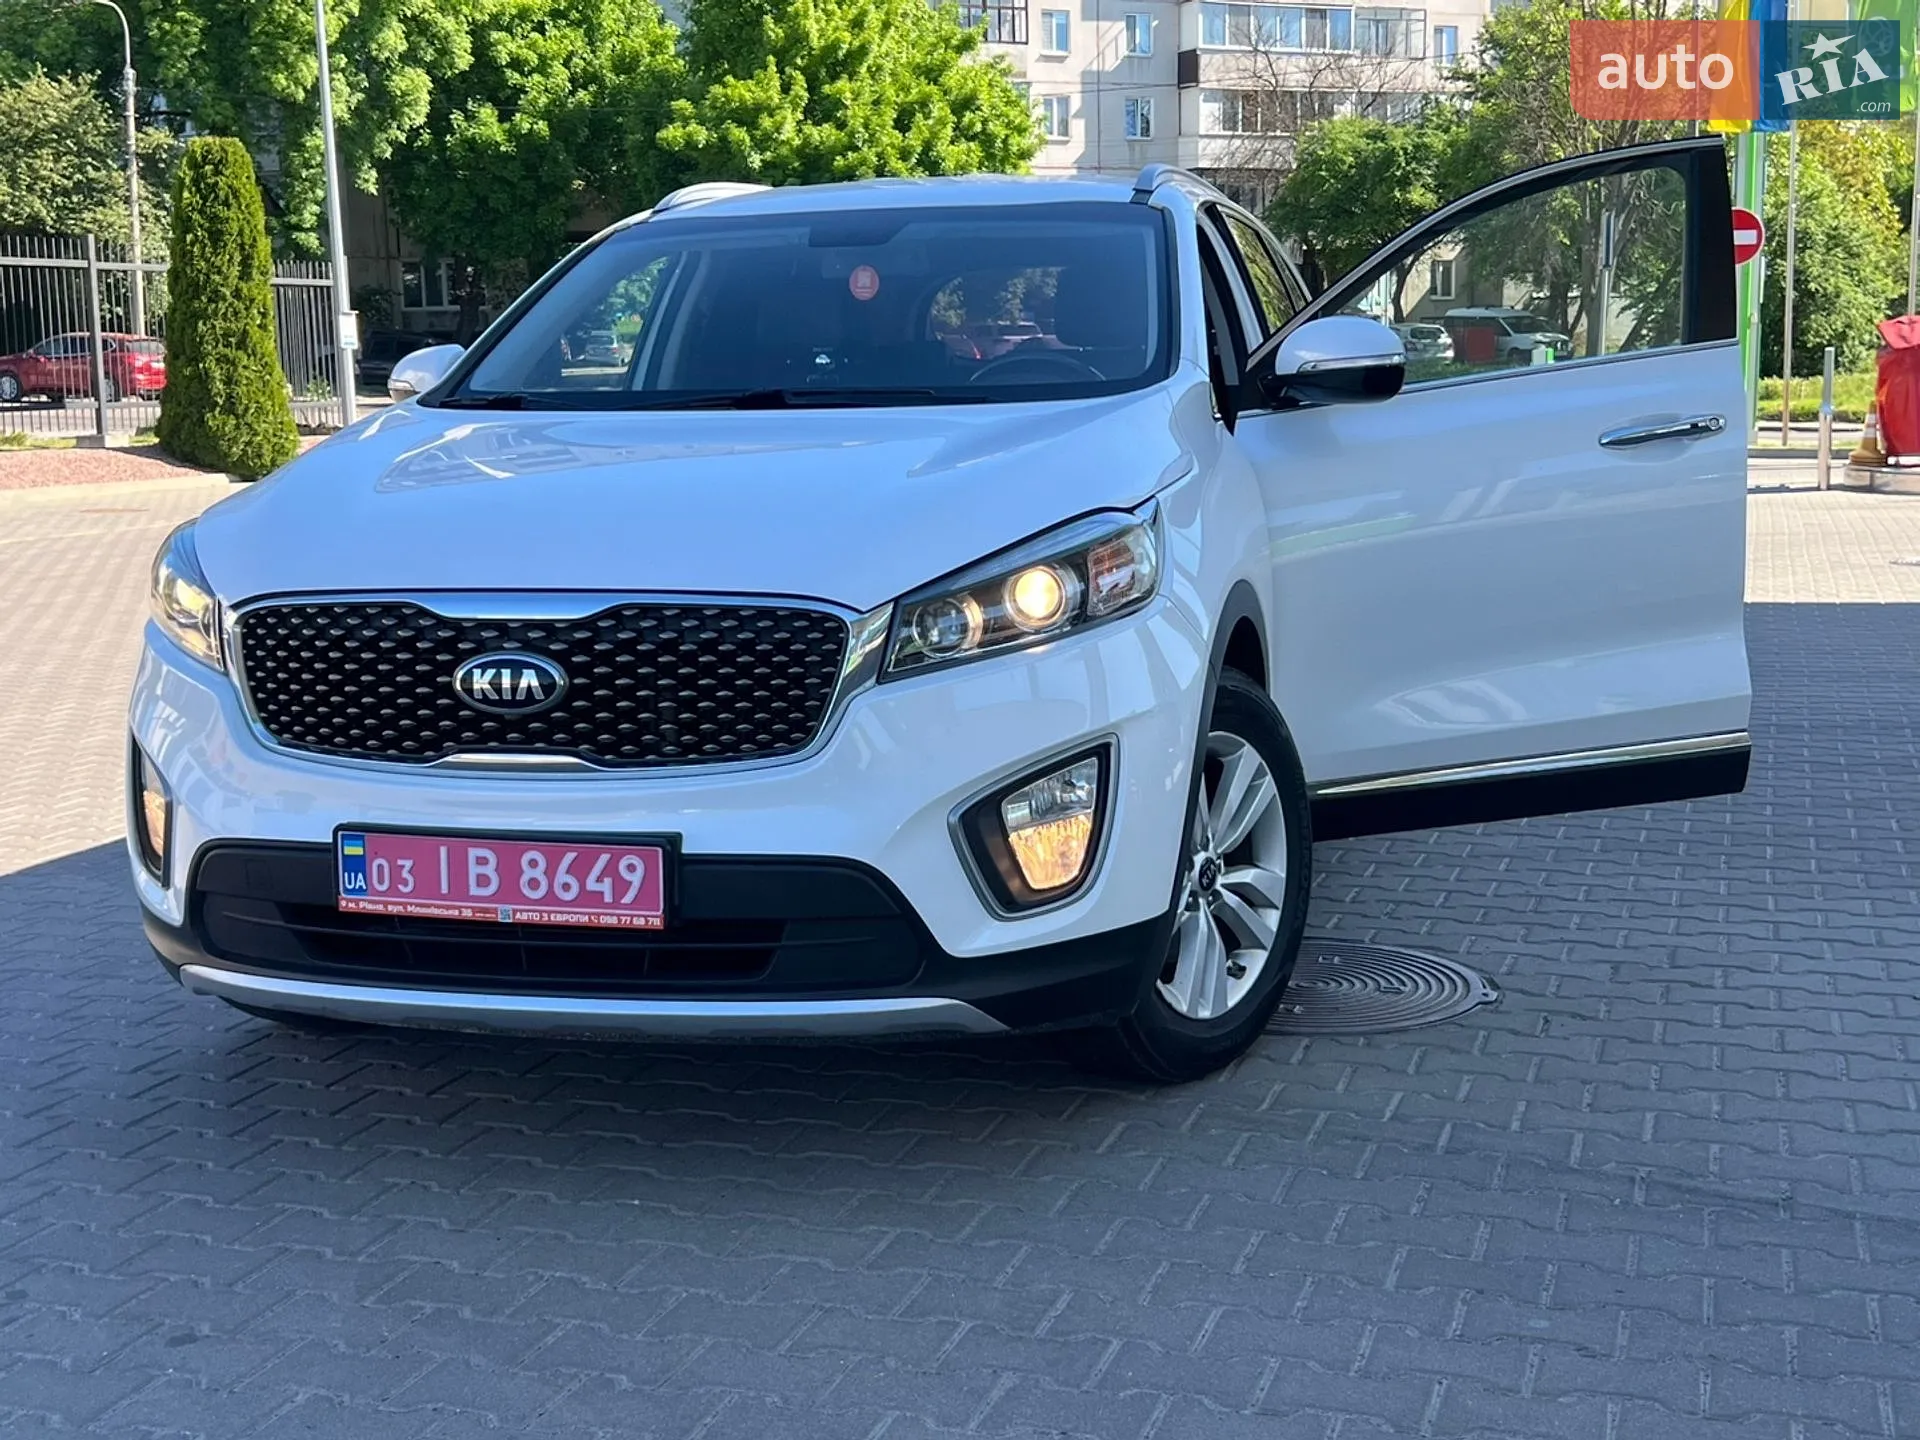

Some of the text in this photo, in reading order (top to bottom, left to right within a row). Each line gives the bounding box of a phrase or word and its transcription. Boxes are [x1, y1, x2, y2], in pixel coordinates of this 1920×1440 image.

[472, 668, 545, 700] KIA
[344, 871, 367, 890] UA
[372, 858, 415, 893] 03
[519, 850, 645, 904] 8649
[515, 911, 540, 921] АВТО
